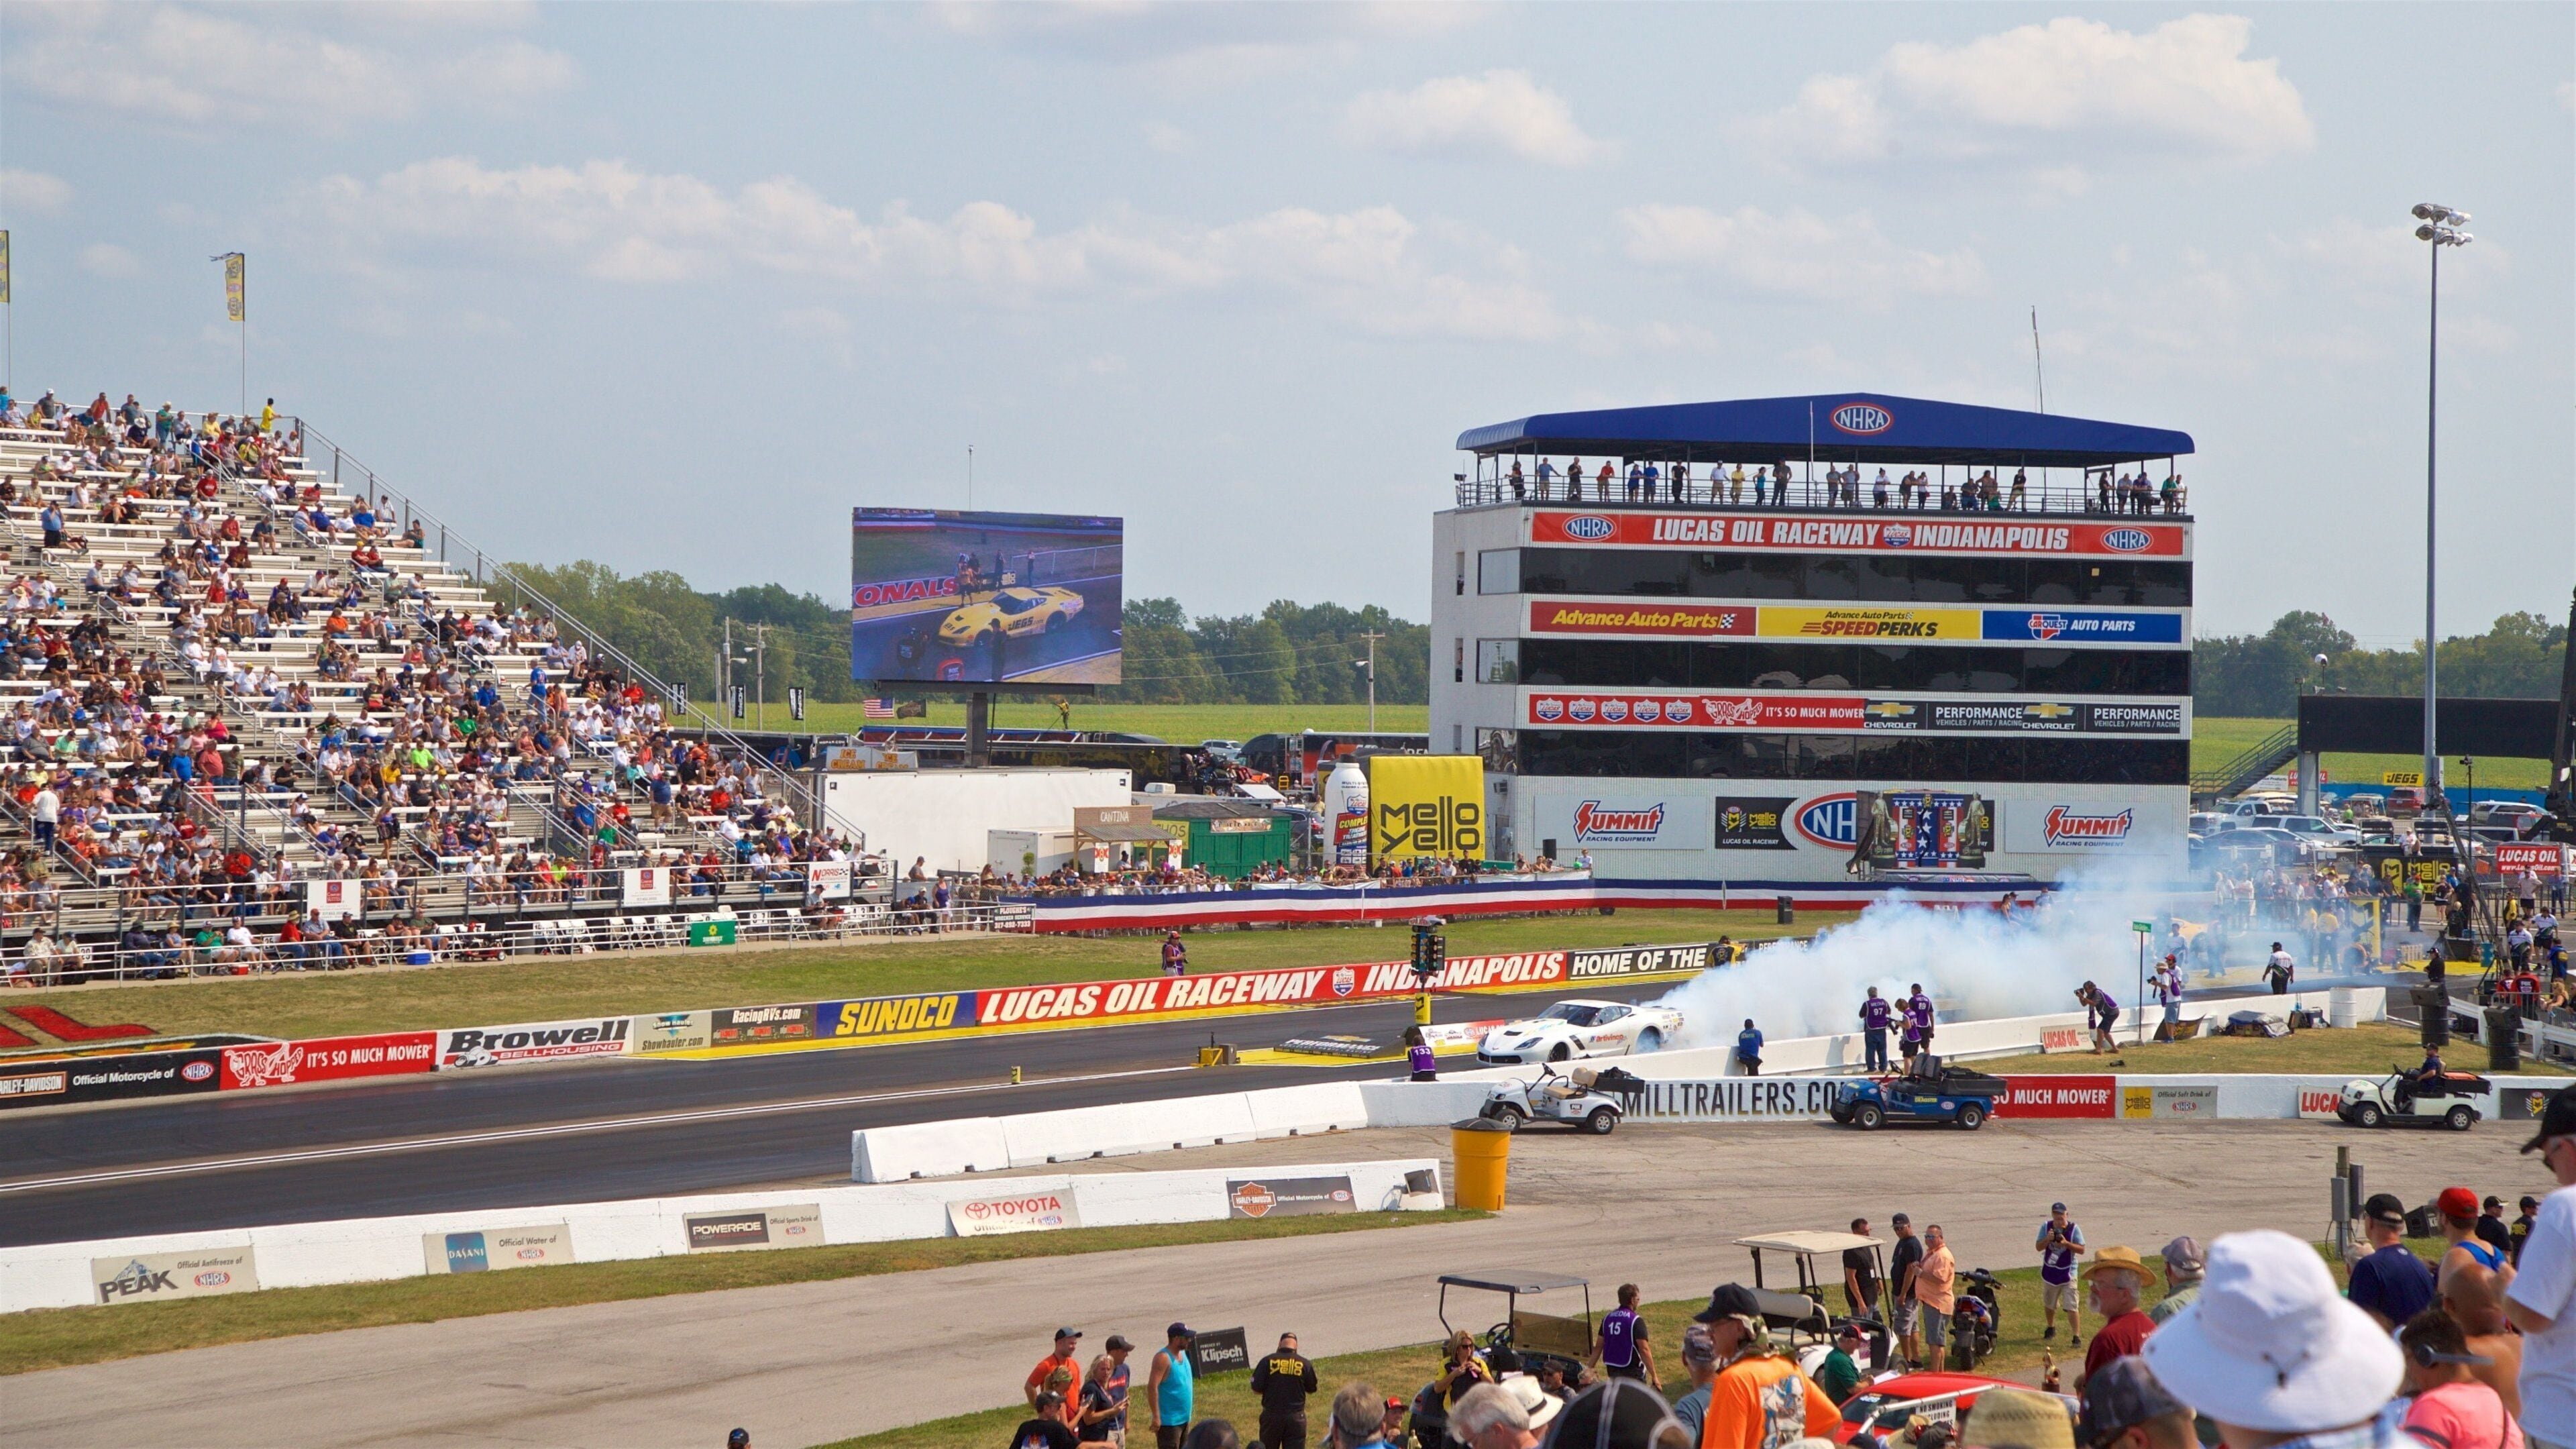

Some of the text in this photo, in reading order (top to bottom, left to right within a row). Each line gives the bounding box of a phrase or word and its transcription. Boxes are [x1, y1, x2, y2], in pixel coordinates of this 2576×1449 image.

[1839, 407, 1886, 431] NHRA
[1568, 519, 1611, 537] NHRA
[1653, 519, 1880, 545] LUCAS OIL RACEWAY
[1914, 525, 2069, 549] INDIANAPOLIS
[2105, 531, 2149, 549] NHRA
[1552, 610, 1719, 629] Advance Auto Parts
[1825, 611, 1905, 621] Advance Auto Parts
[1821, 621, 1938, 637] SPEEDPERKS
[2028, 619, 2136, 632] CARQUEST AUTO PARTS
[1766, 706, 1864, 718] IT'S SO MUCH MOWER
[1935, 706, 2023, 719] PERFORMANCE
[2094, 708, 2180, 720] PERFORMANCE
[1864, 721, 1917, 729] CHEVROLET
[840, 749, 857, 759] ICE
[2386, 773, 2419, 784] JEGS
[1100, 810, 1130, 822] CANTINA
[2498, 850, 2558, 862] LUCAS OIL
[1571, 947, 1707, 976] HOME OF THE
[1362, 953, 1564, 992] INDANAPOLIS
[981, 969, 1327, 1023] LUCAS OIL RACEWAY
[732, 1008, 802, 1024] RacingRVs.com
[835, 996, 959, 1036] SUNOCO
[447, 1020, 631, 1053] Browell
[642, 1036, 704, 1051] Showhauler.com
[2043, 1029, 2080, 1049] LUCAS OIL
[307, 1052, 329, 1069] IT'S
[331, 1051, 347, 1065] SO
[350, 1046, 384, 1064] MUCH
[499, 1044, 621, 1059] BELLHOUSING
[1415, 1048, 1431, 1056] 133
[72, 1068, 175, 1086] Official Motorcycle of
[184, 1063, 211, 1079] NHRA
[0, 1076, 62, 1093] ARLEY-DAVIDSON
[2015, 1089, 2052, 1105] MUCH
[2206, 1090, 2211, 1098] of
[2176, 1102, 2194, 1112] NHRA
[991, 1196, 1061, 1216] TOYOTA
[692, 1221, 762, 1236] POWERADE
[498, 1235, 557, 1247] Official Water of
[448, 1248, 485, 1259] DASANI
[177, 1256, 243, 1269] Official Antifreeze of
[99, 1269, 179, 1303] PEAK
[199, 1273, 227, 1286] NHRA
[1610, 1309, 1631, 1318] MEDIA
[1608, 1322, 1621, 1336] 15
[1200, 1344, 1243, 1363] Klipsch
[1919, 1400, 1953, 1413] NO SMOKING
